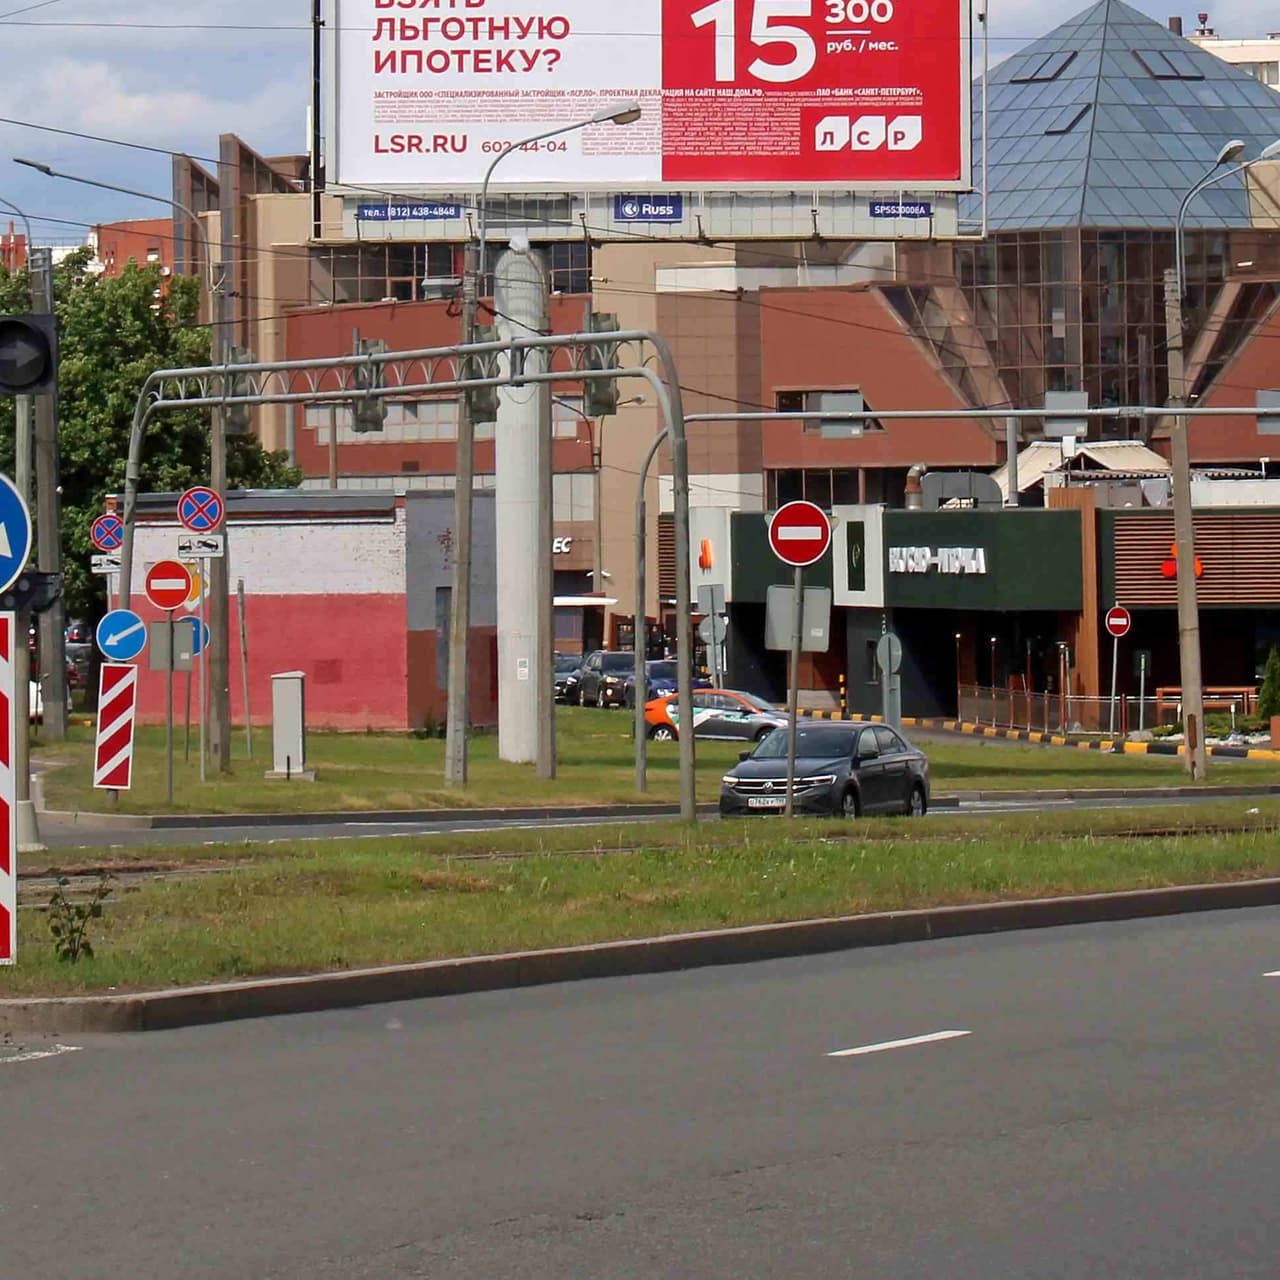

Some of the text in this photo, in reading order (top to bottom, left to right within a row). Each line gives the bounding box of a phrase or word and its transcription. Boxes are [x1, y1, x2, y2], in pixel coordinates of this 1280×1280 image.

[372, 16, 570, 41] ЛЬГОТНУЮ
[826, 39, 856, 53] руб.
[868, 39, 899, 52] мес.
[374, 48, 561, 73] ИПОТЕКУ?
[374, 135, 567, 153] LSR.RU 60244-04
[642, 203, 674, 215] Russ
